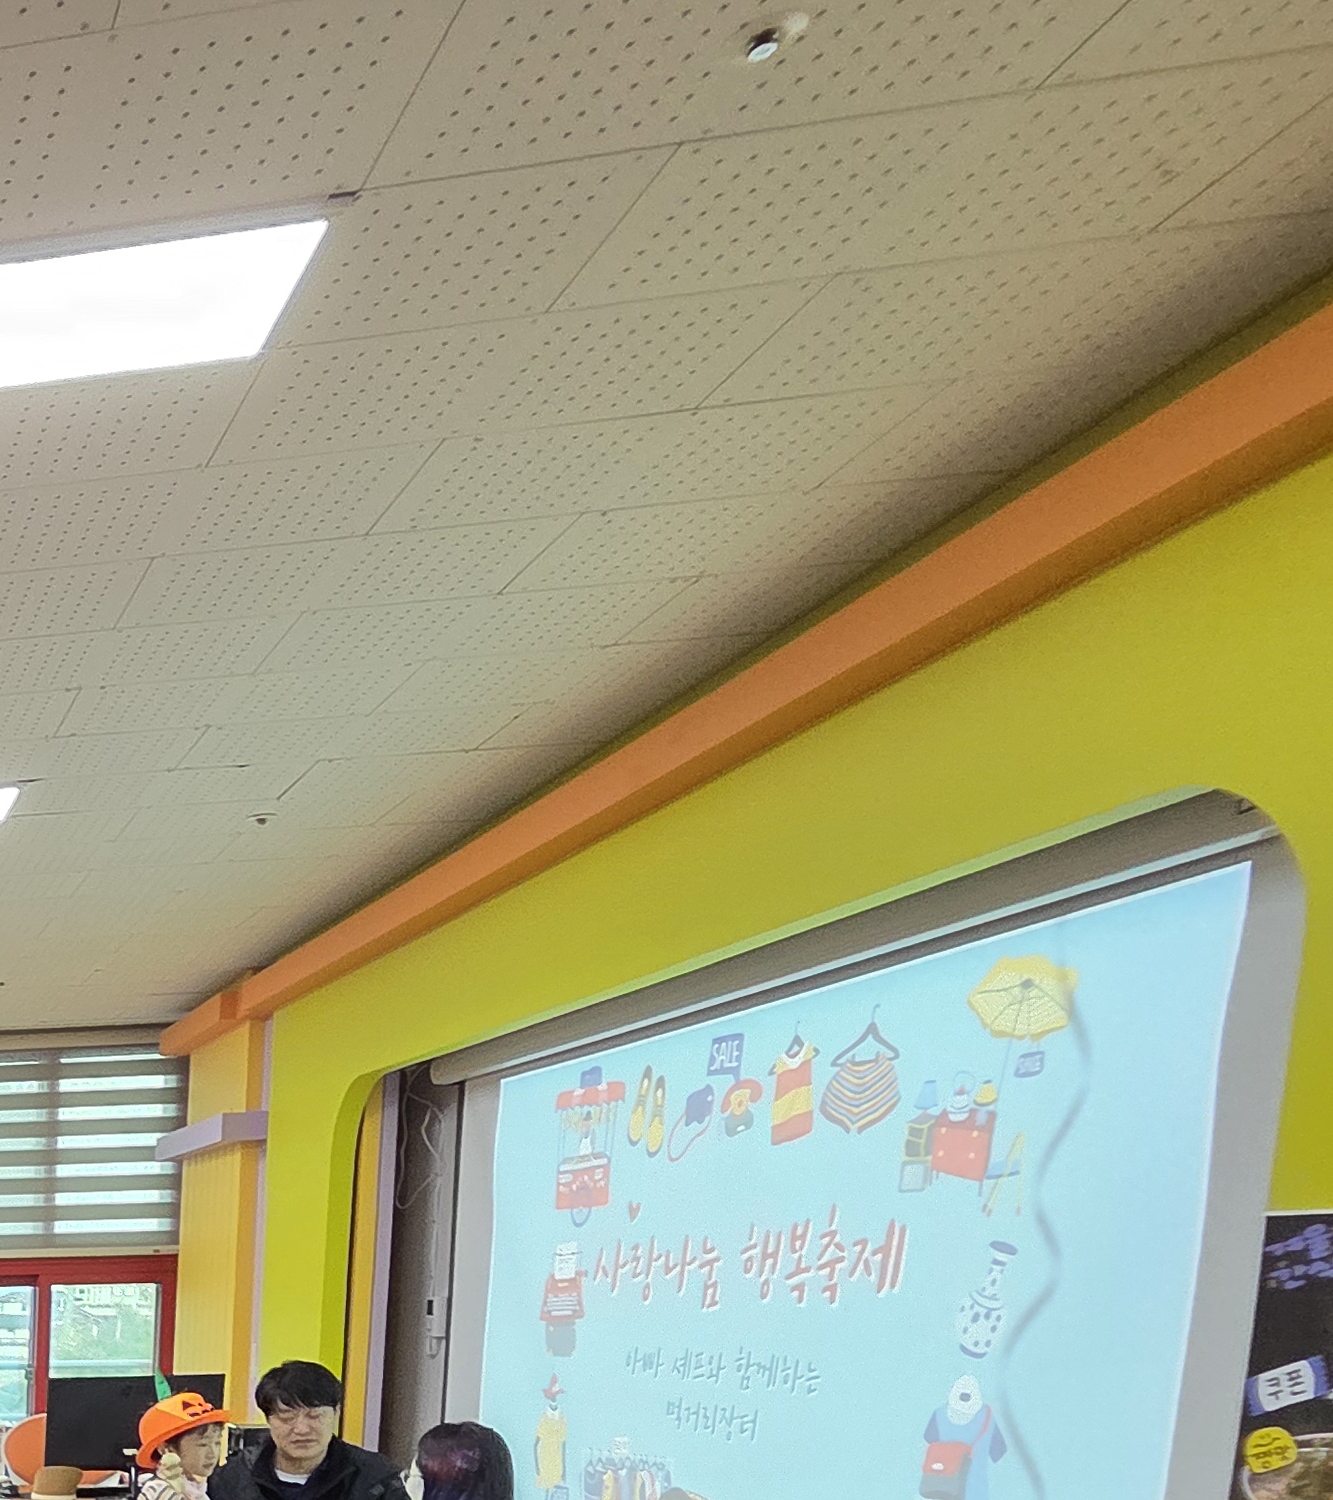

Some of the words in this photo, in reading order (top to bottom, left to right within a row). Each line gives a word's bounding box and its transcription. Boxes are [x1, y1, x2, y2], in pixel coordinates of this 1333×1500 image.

[709, 1040, 740, 1071] SALE
[593, 1234, 722, 1311] 사랑나눔
[740, 1203, 908, 1307] 행복축제
[625, 1346, 665, 1378] 아빠
[735, 1345, 821, 1394] 함께하는
[1265, 1368, 1308, 1400] 쿠폰
[666, 1397, 759, 1441] 먹거리장터
